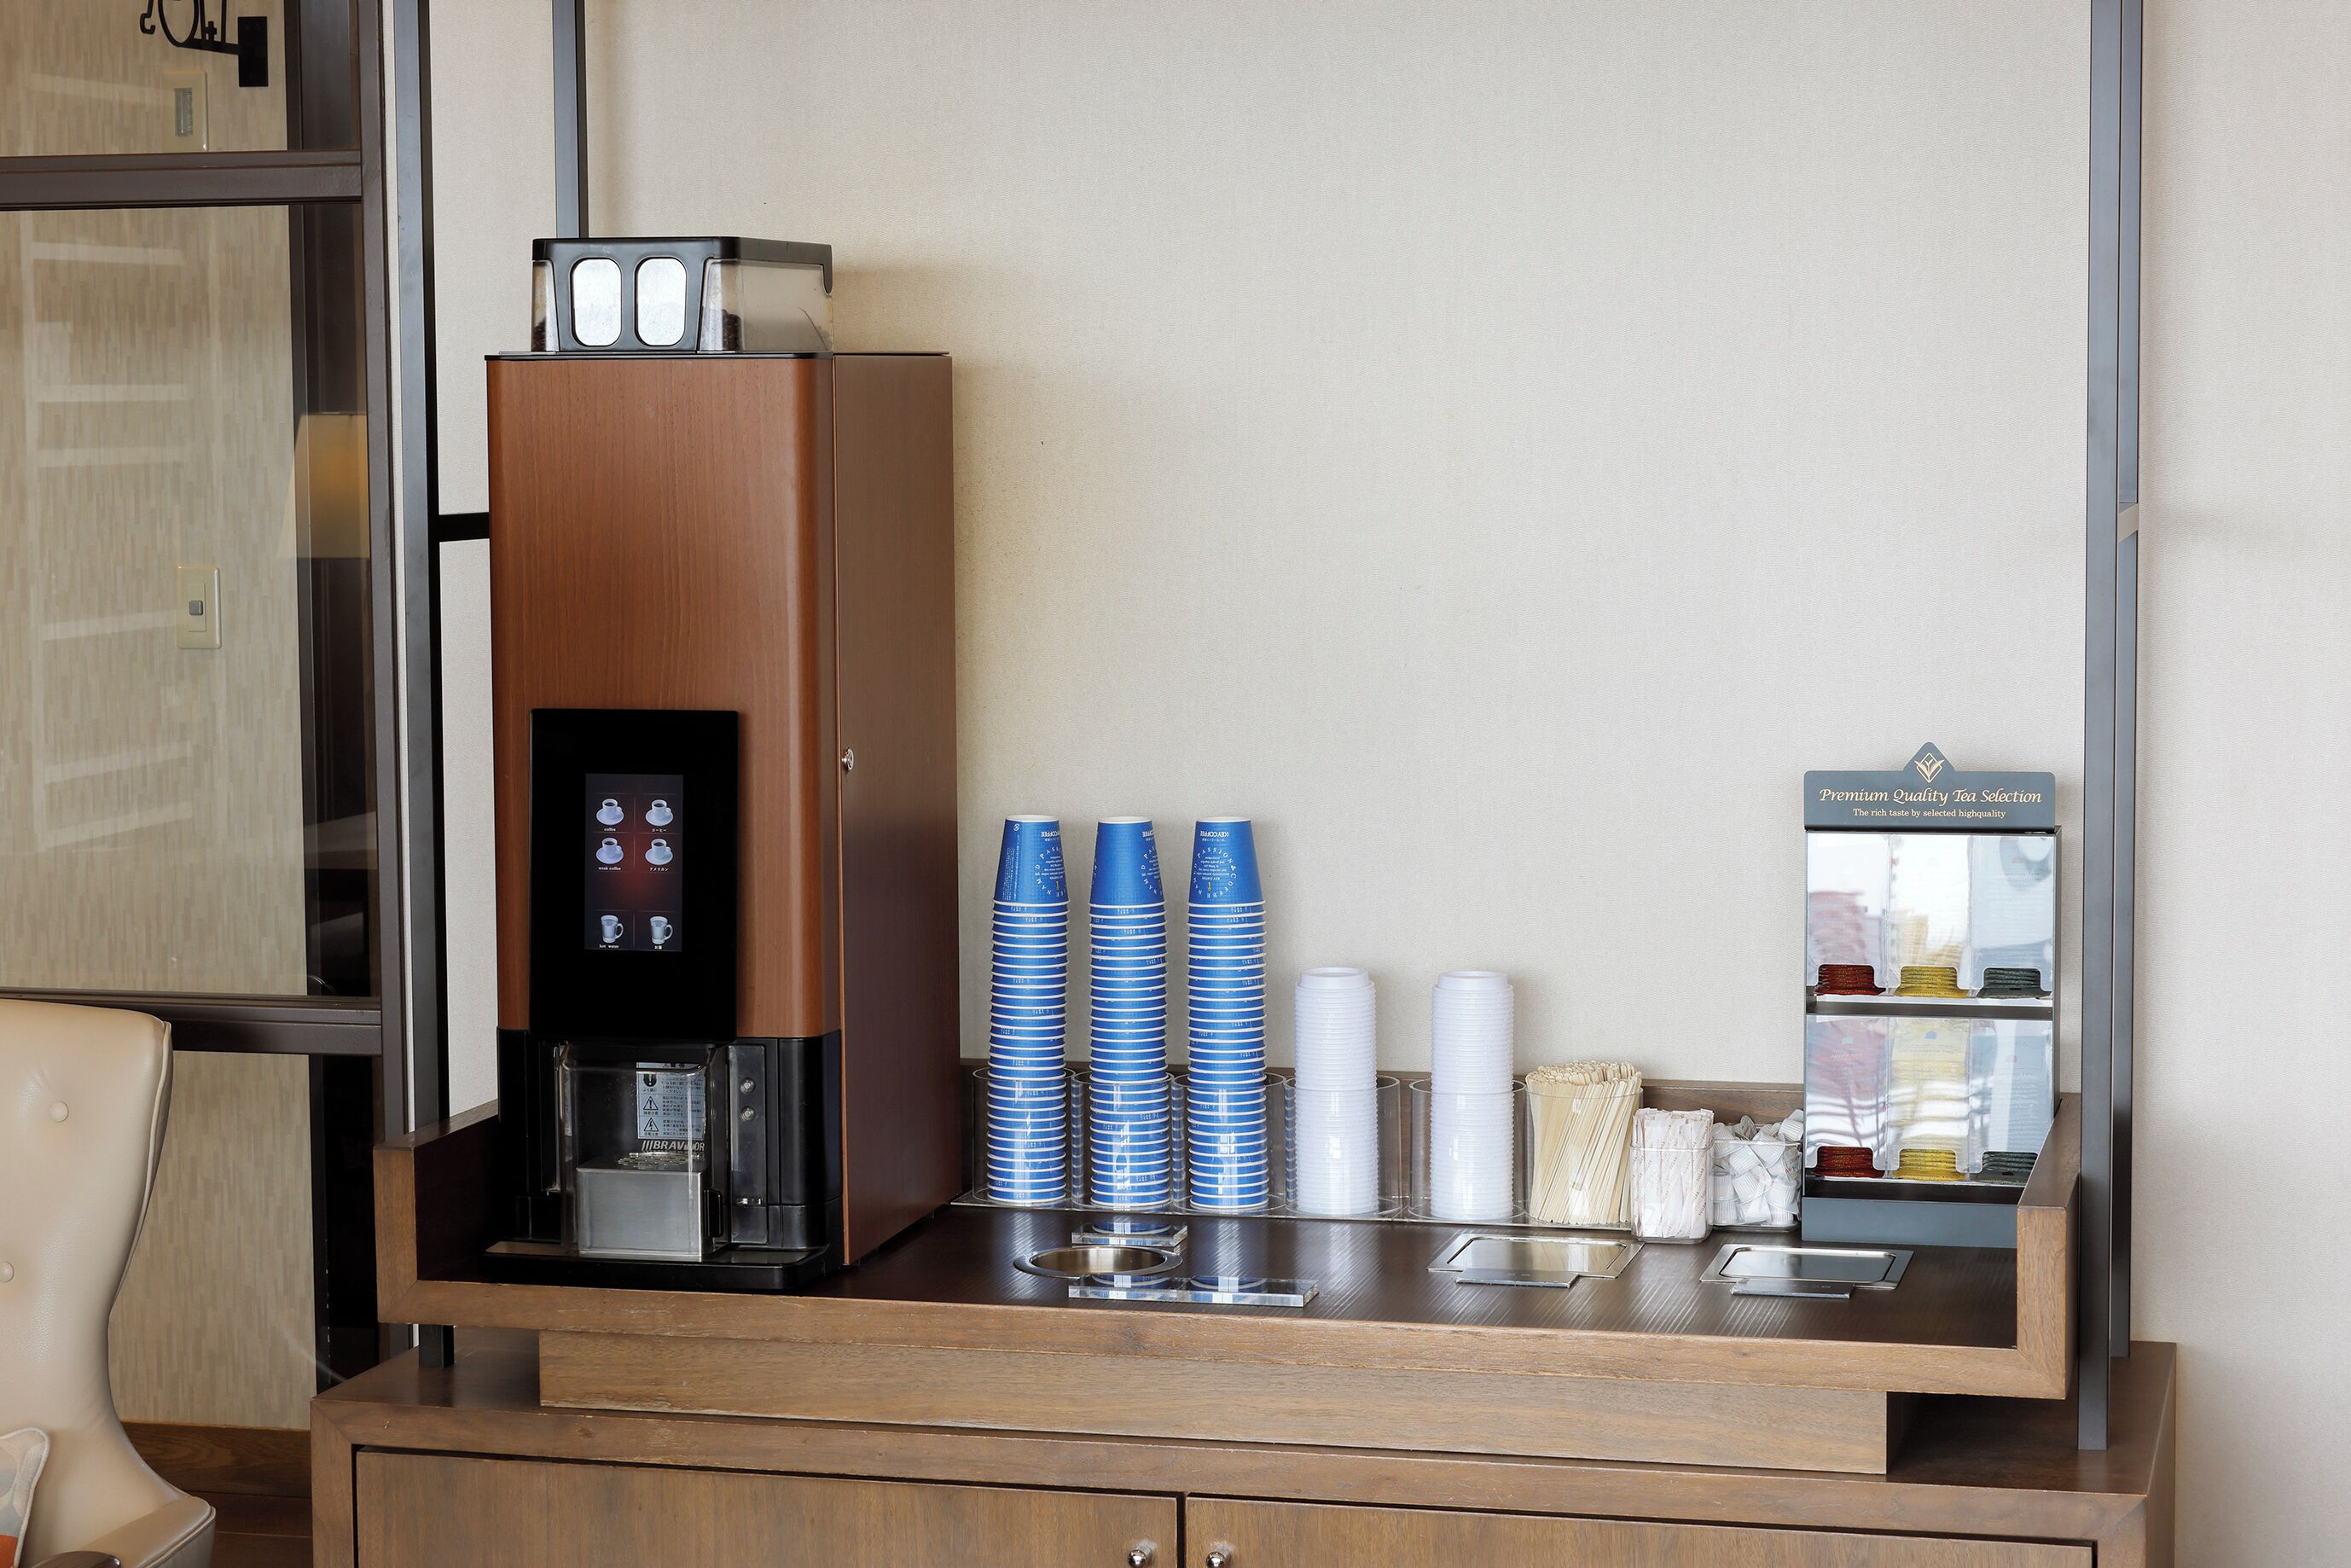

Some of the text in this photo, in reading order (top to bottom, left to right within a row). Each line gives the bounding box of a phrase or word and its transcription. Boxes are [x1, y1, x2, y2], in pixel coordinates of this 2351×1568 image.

[1819, 787, 2042, 807] Premium Quality Tea Selection
[1853, 808, 2006, 819] The rich taste by selected highquality
[653, 1140, 705, 1152] BRAVOR
